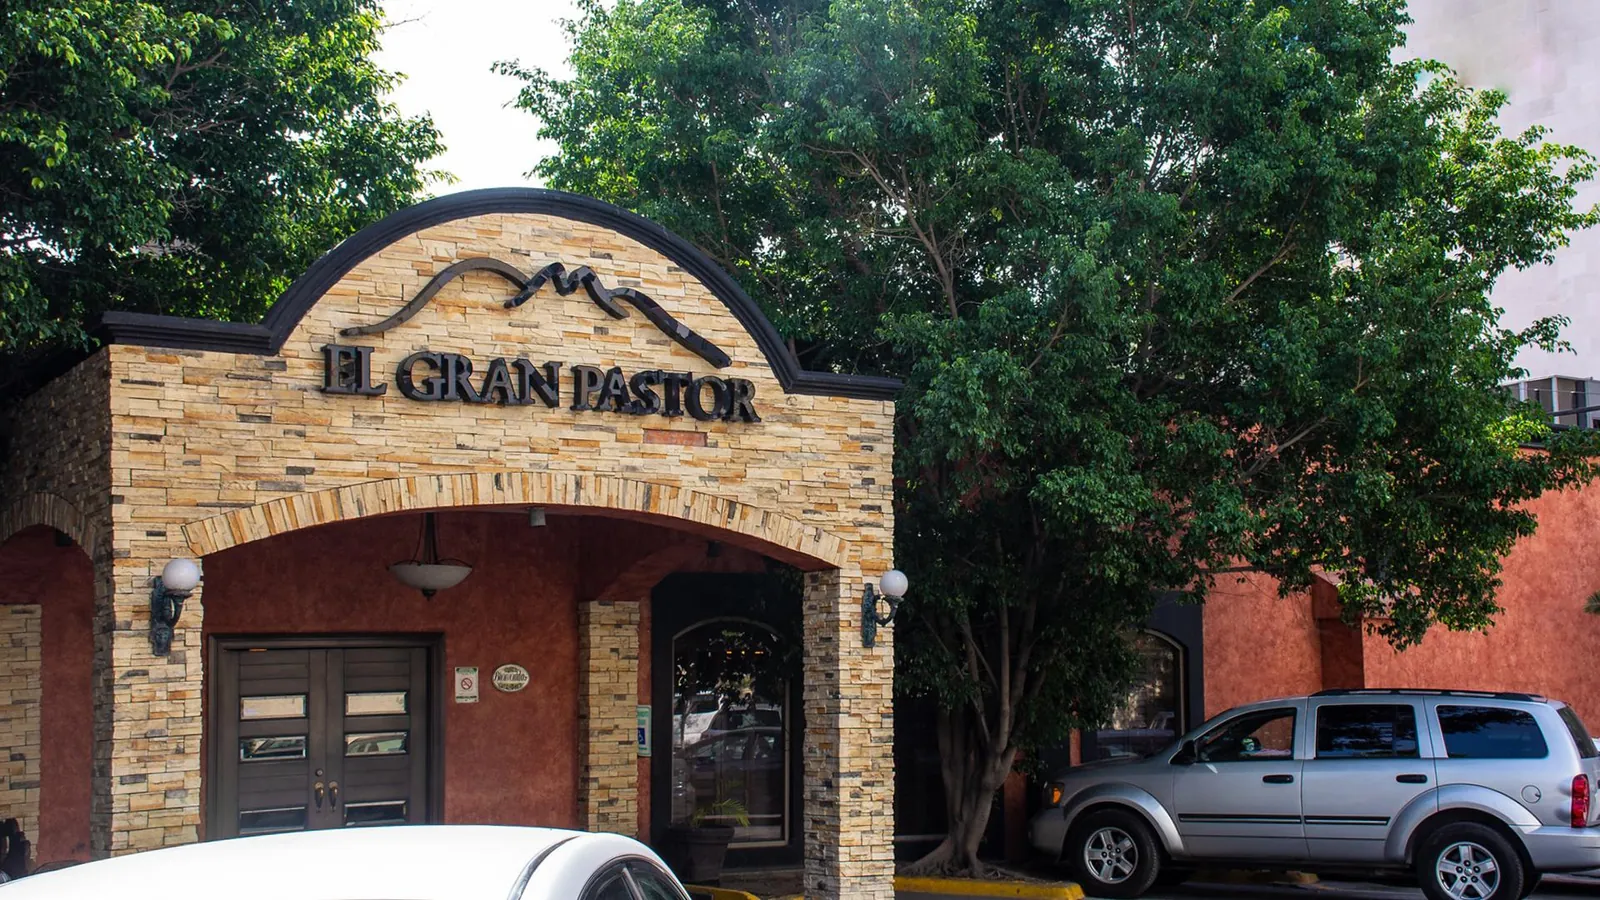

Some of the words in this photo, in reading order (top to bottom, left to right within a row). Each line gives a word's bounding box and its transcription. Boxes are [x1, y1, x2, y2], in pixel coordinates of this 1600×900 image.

[321, 344, 387, 396] EL
[396, 351, 562, 408] GRAN
[571, 365, 761, 423] PASTOR
